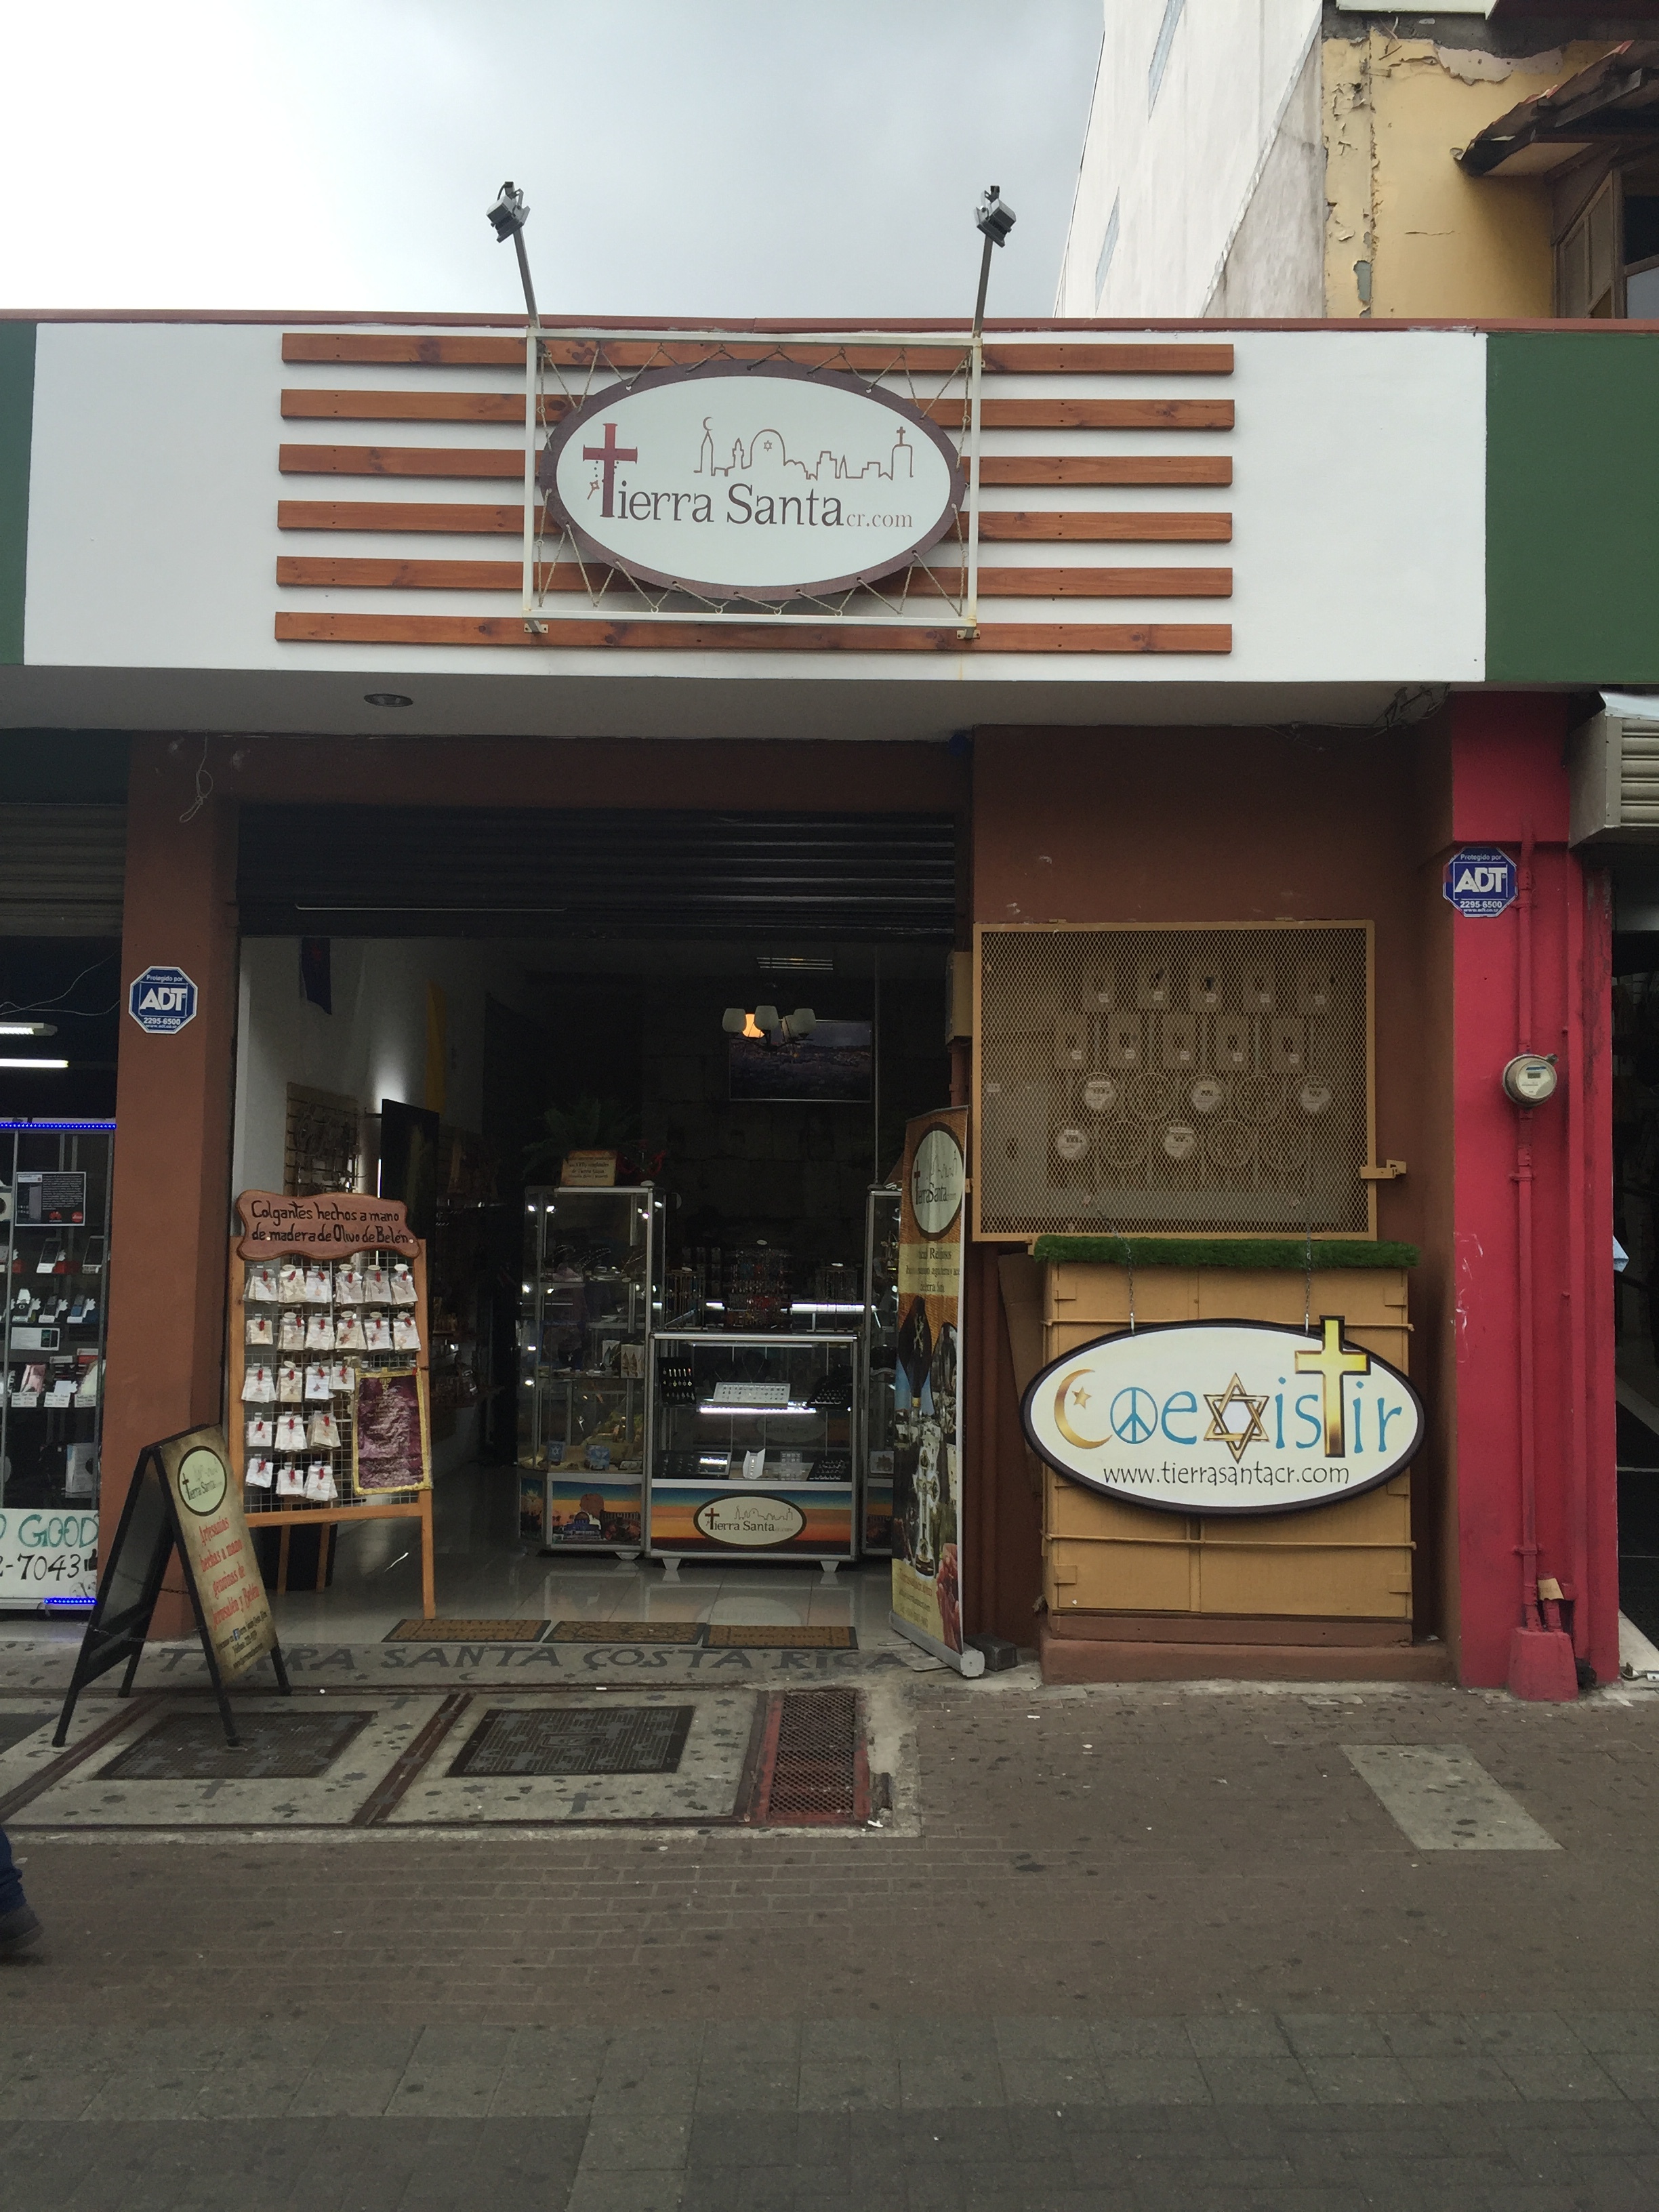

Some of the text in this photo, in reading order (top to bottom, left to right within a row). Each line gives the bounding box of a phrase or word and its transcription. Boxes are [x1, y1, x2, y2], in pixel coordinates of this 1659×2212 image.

[583, 422, 714, 523] Tierra
[1454, 867, 1507, 893] ADT
[146, 975, 173, 983] Protegido
[139, 987, 187, 1011] ADT
[144, 1017, 181, 1025] 2295-6500
[251, 1200, 399, 1226] Colgantes hechos a mano
[251, 1222, 408, 1244] de madera de Olivo de Belén
[1103, 1460, 1349, 1487] www.tierrasantacr.com
[18, 1514, 100, 1548] GOOD
[704, 1507, 740, 1531] Tierra
[380, 1646, 563, 1668] SANTA
